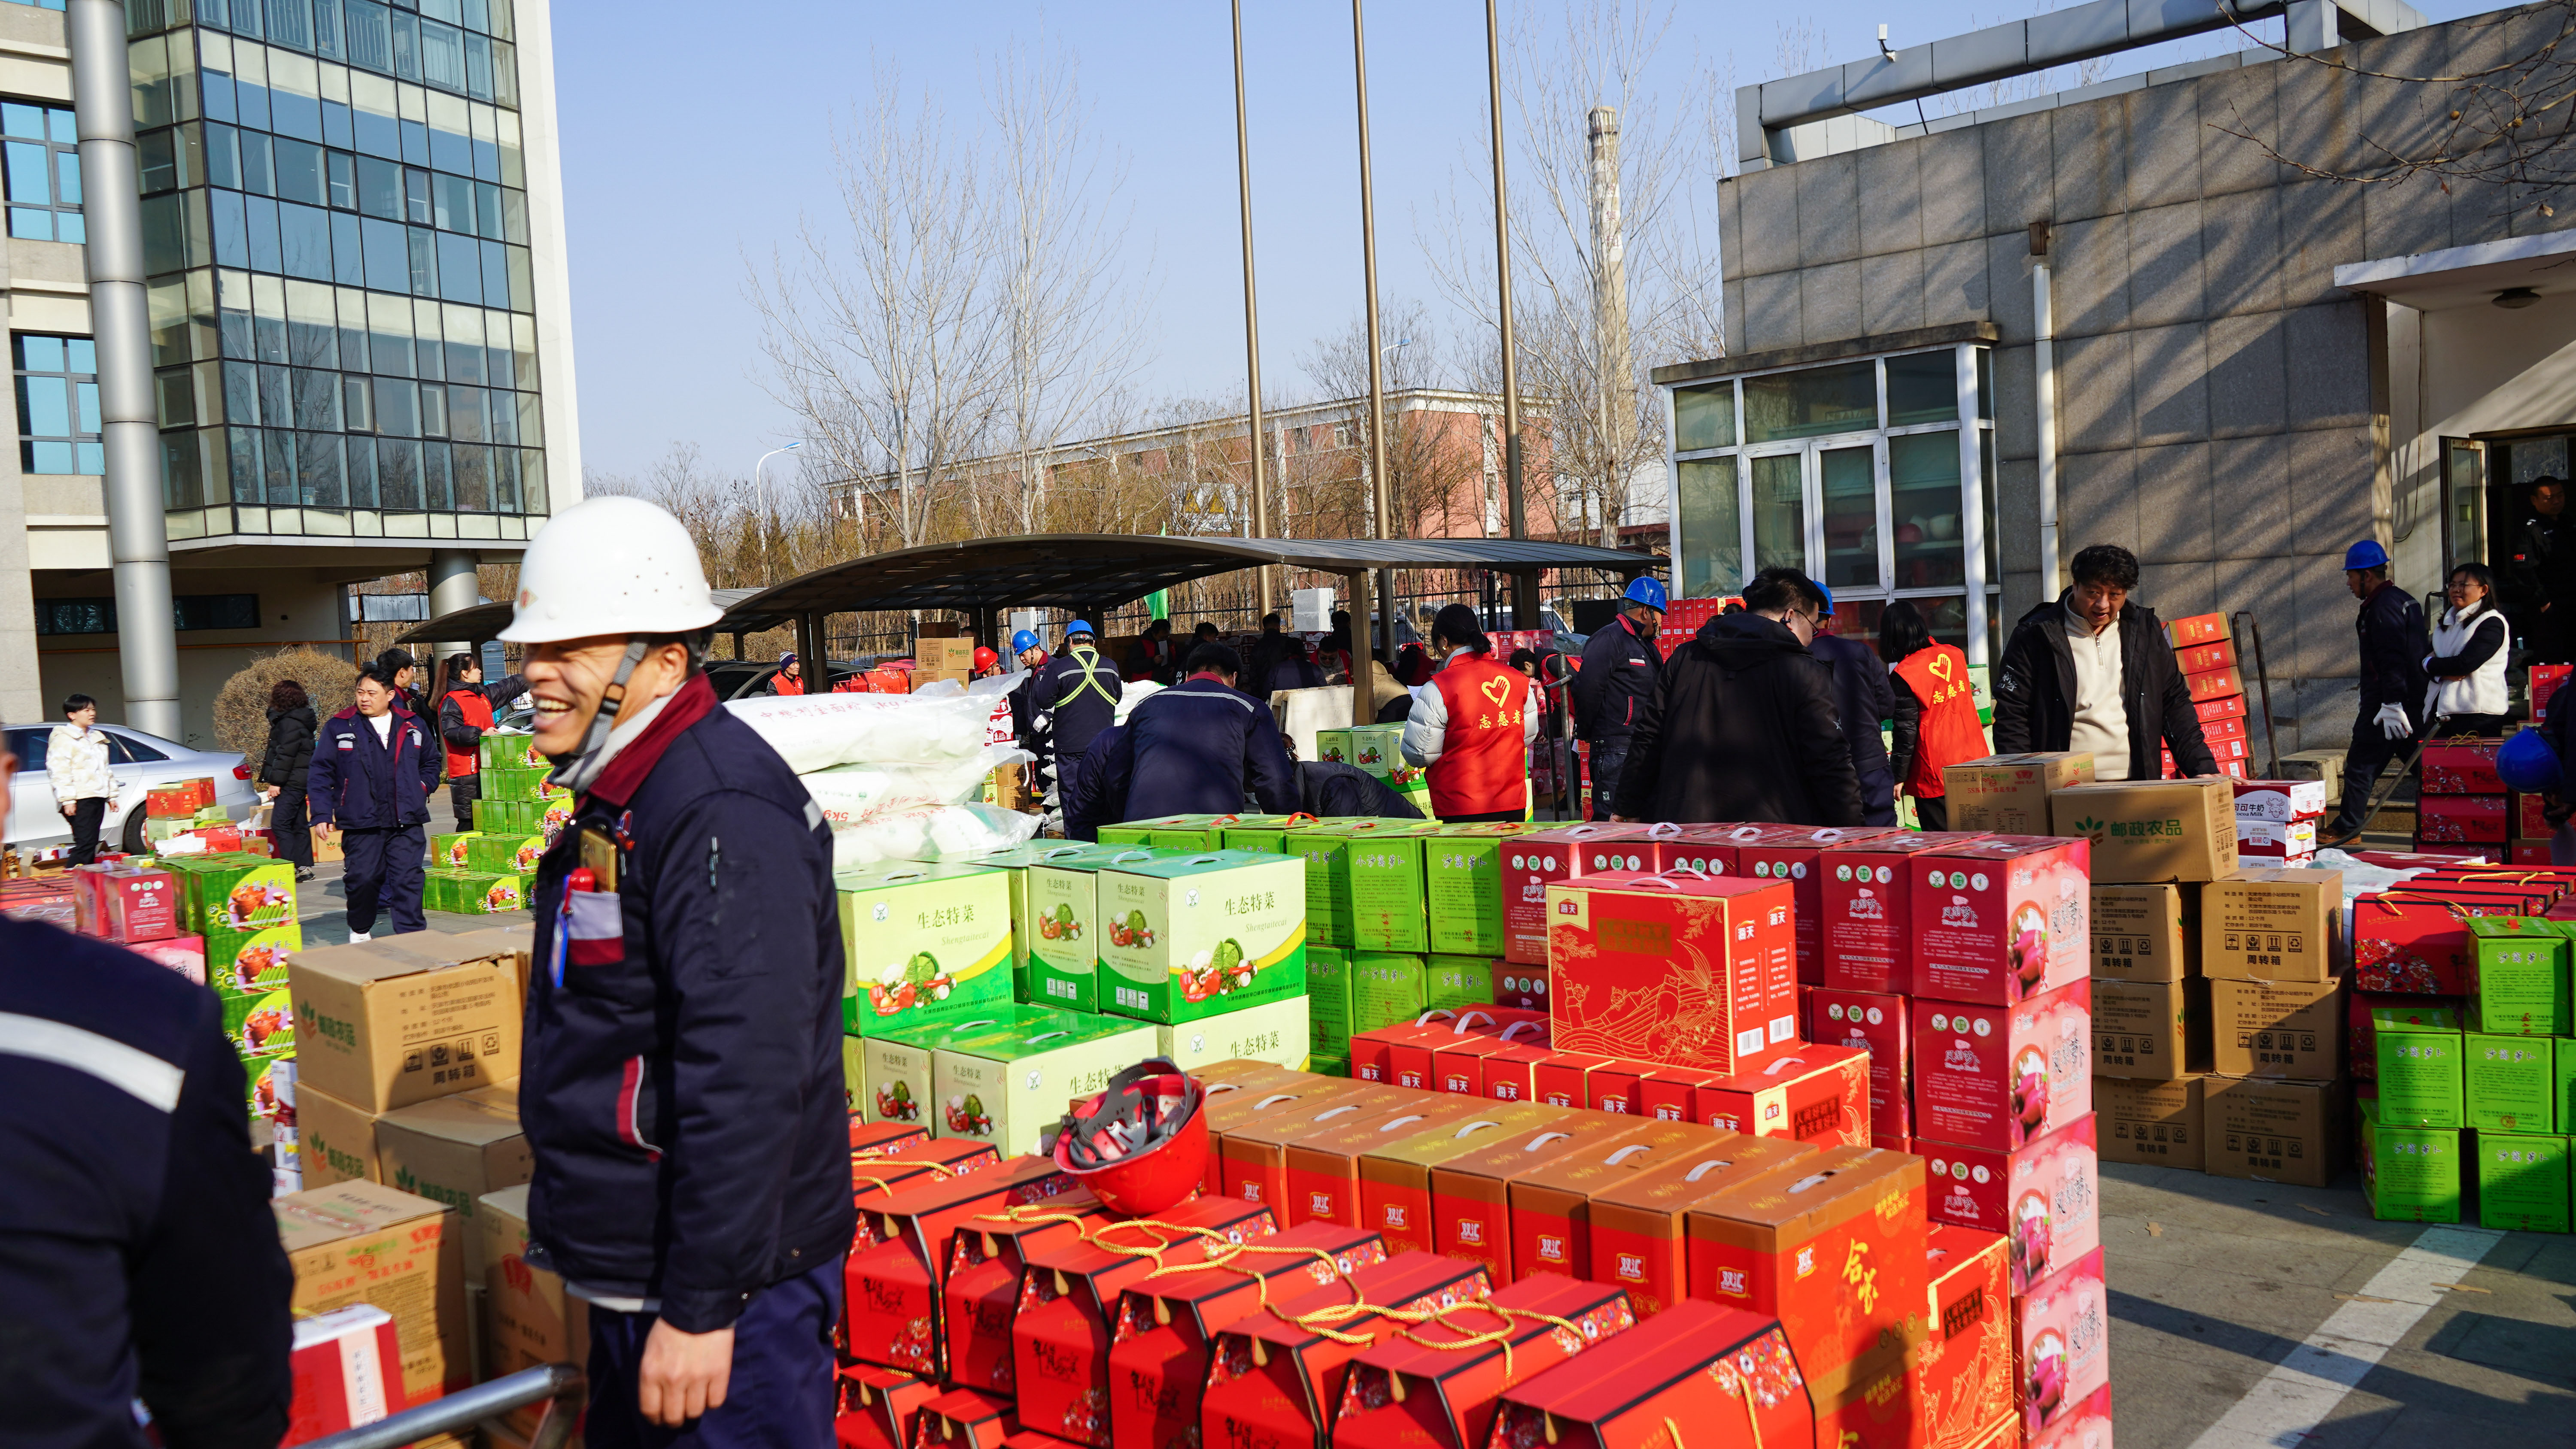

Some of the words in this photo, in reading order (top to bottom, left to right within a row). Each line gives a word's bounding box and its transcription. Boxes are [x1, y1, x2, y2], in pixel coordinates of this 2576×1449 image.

[1933, 680, 1965, 704] 志愿者
[1479, 710, 1521, 729] 志愿者
[2234, 803, 2264, 812] 可可牛奶
[823, 809, 849, 822] 5kg
[2111, 819, 2182, 837] 邮政农品
[1356, 854, 1405, 869] 小沙窝萝卜
[1442, 854, 1487, 870] 沙窝萝卜
[240, 879, 286, 892] 沙窝萝卜
[1047, 878, 1072, 891] 生态特菜
[1118, 883, 1145, 897] 生态特菜
[1118, 895, 1144, 903] Shengtaitecai
[1225, 891, 1274, 917] 生态特菜
[1850, 898, 1883, 914] 凤梨萝卜
[1561, 904, 1576, 914] 海天
[1942, 906, 1978, 922] 凤梨萝卜
[917, 904, 975, 930] 生态特菜
[1770, 912, 1786, 925] 海天
[1246, 918, 1287, 932] Shengtaitecai
[942, 931, 989, 946] Shengtaitecai
[1738, 926, 1755, 941] 海天
[246, 940, 293, 954] 沙窝萝卜
[2102, 958, 2132, 968] 周转箱
[2247, 955, 2281, 965] 周转箱
[2497, 951, 2549, 965] 沙窝萝卜
[1360, 966, 1407, 983] 小沙窝萝卜
[1441, 972, 1483, 990] 沙窝萝卜
[1230, 1030, 1279, 1058] 生态特菜
[1945, 1049, 1980, 1066] 凤梨萝卜
[2260, 1053, 2293, 1064] 周转箱
[2395, 1045, 2445, 1059] 沙窝萝卜
[2485, 1047, 2536, 1063] 沙窝萝卜
[882, 1053, 907, 1066] 生态特菜
[2104, 1055, 2134, 1065] 周转箱
[433, 1064, 475, 1085] 周转箱
[954, 1065, 981, 1080] 生态特菜
[1362, 1067, 1379, 1081] 海天
[1402, 1075, 1420, 1089] 海天
[1449, 1079, 1467, 1092] 海天
[1497, 1085, 1517, 1100] 海天
[1603, 1099, 1626, 1113] 海天
[1766, 1106, 1778, 1119] 海天
[1657, 1109, 1680, 1121] 海天
[2136, 1143, 2167, 1155] 周转箱
[2392, 1142, 2442, 1156] 沙窝萝卜
[2249, 1156, 2281, 1169] 周转箱
[2496, 1149, 2549, 1164] 沙窝萝卜
[1245, 1184, 1259, 1197] 双汇
[1312, 1195, 1329, 1208] 双汇
[1387, 1207, 1403, 1221] 双汇
[1461, 1222, 1479, 1236] 双汇
[1540, 1238, 1561, 1253] 双汇
[1619, 1257, 1641, 1273] 双汇
[1720, 1270, 1744, 1287] 双汇
